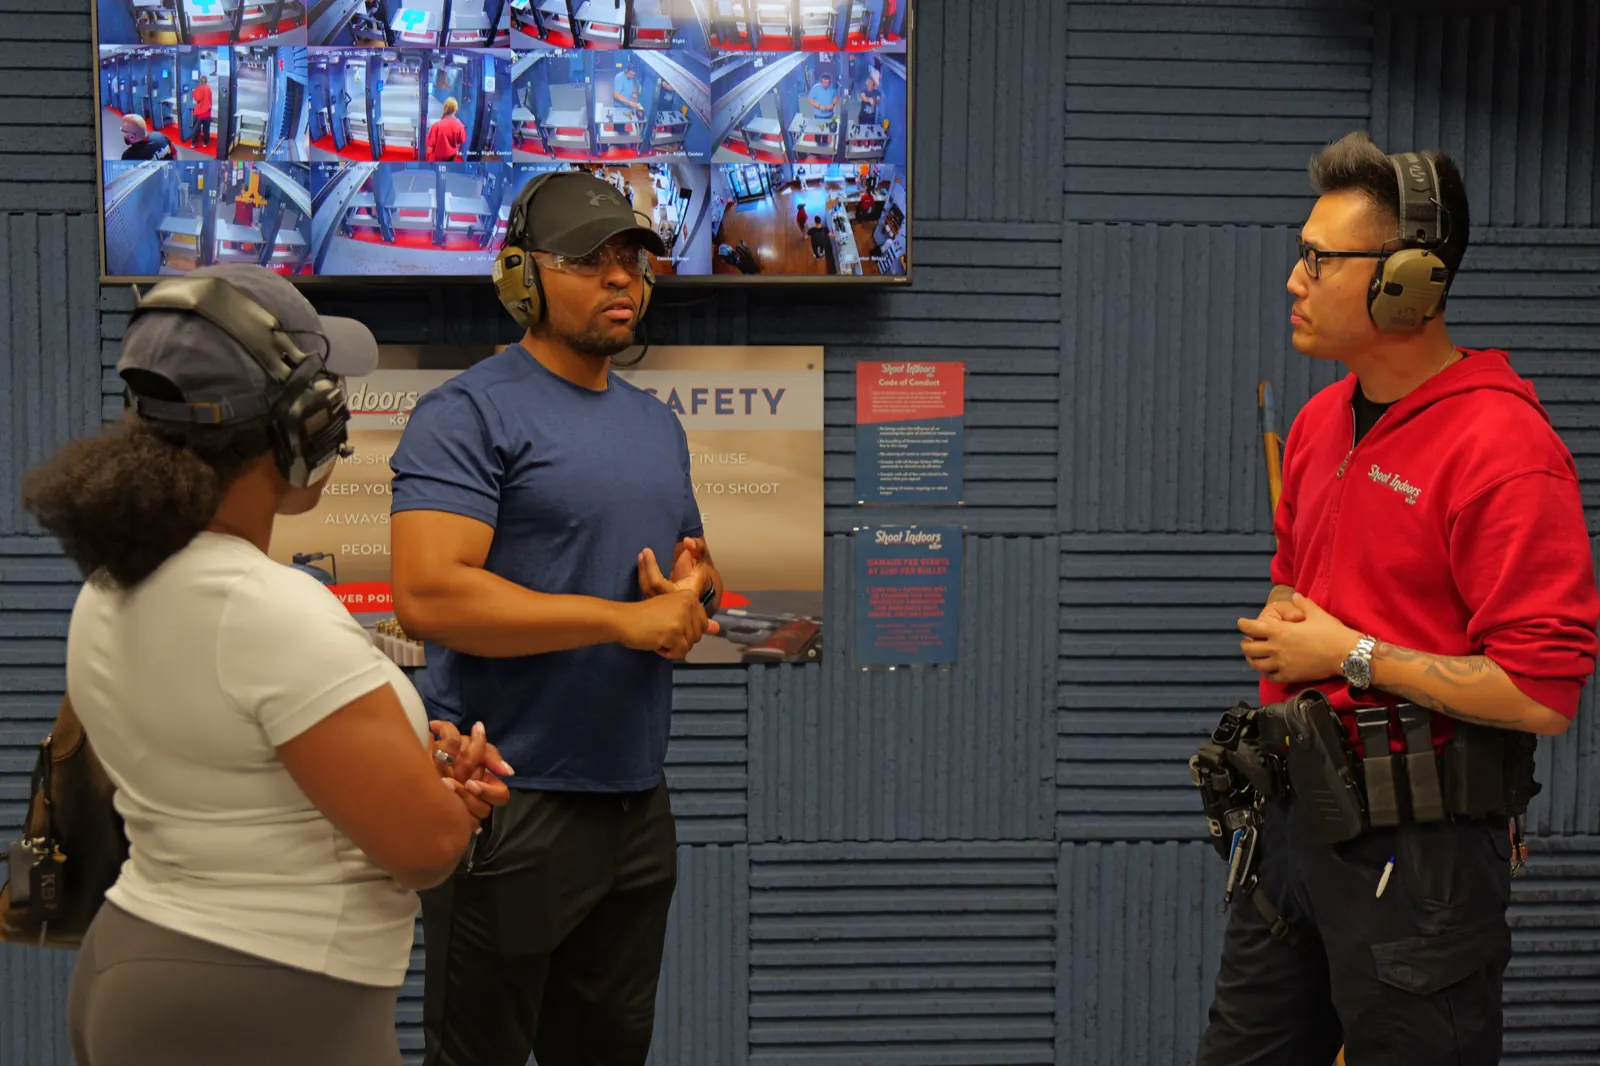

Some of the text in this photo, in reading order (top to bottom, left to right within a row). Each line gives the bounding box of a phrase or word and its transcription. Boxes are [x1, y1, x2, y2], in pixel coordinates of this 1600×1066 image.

[881, 363, 905, 376] Shoot
[905, 363, 936, 376] Indoors
[878, 378, 940, 386] Code of Conduct
[348, 383, 419, 412] doors
[643, 386, 786, 416] AFETY
[699, 453, 714, 465] IN
[719, 453, 747, 465] USE
[1368, 464, 1421, 497] Shoot Indoors
[321, 484, 360, 496] KEEP
[705, 483, 725, 495] TO
[728, 483, 780, 495] SHOOT
[325, 513, 389, 525] ALWAYS
[875, 530, 942, 545] Shoot Indoors
[341, 544, 391, 556] PEOPL
[868, 567, 878, 575] AT
[900, 567, 915, 575] PER
[336, 594, 393, 603] VER POI
